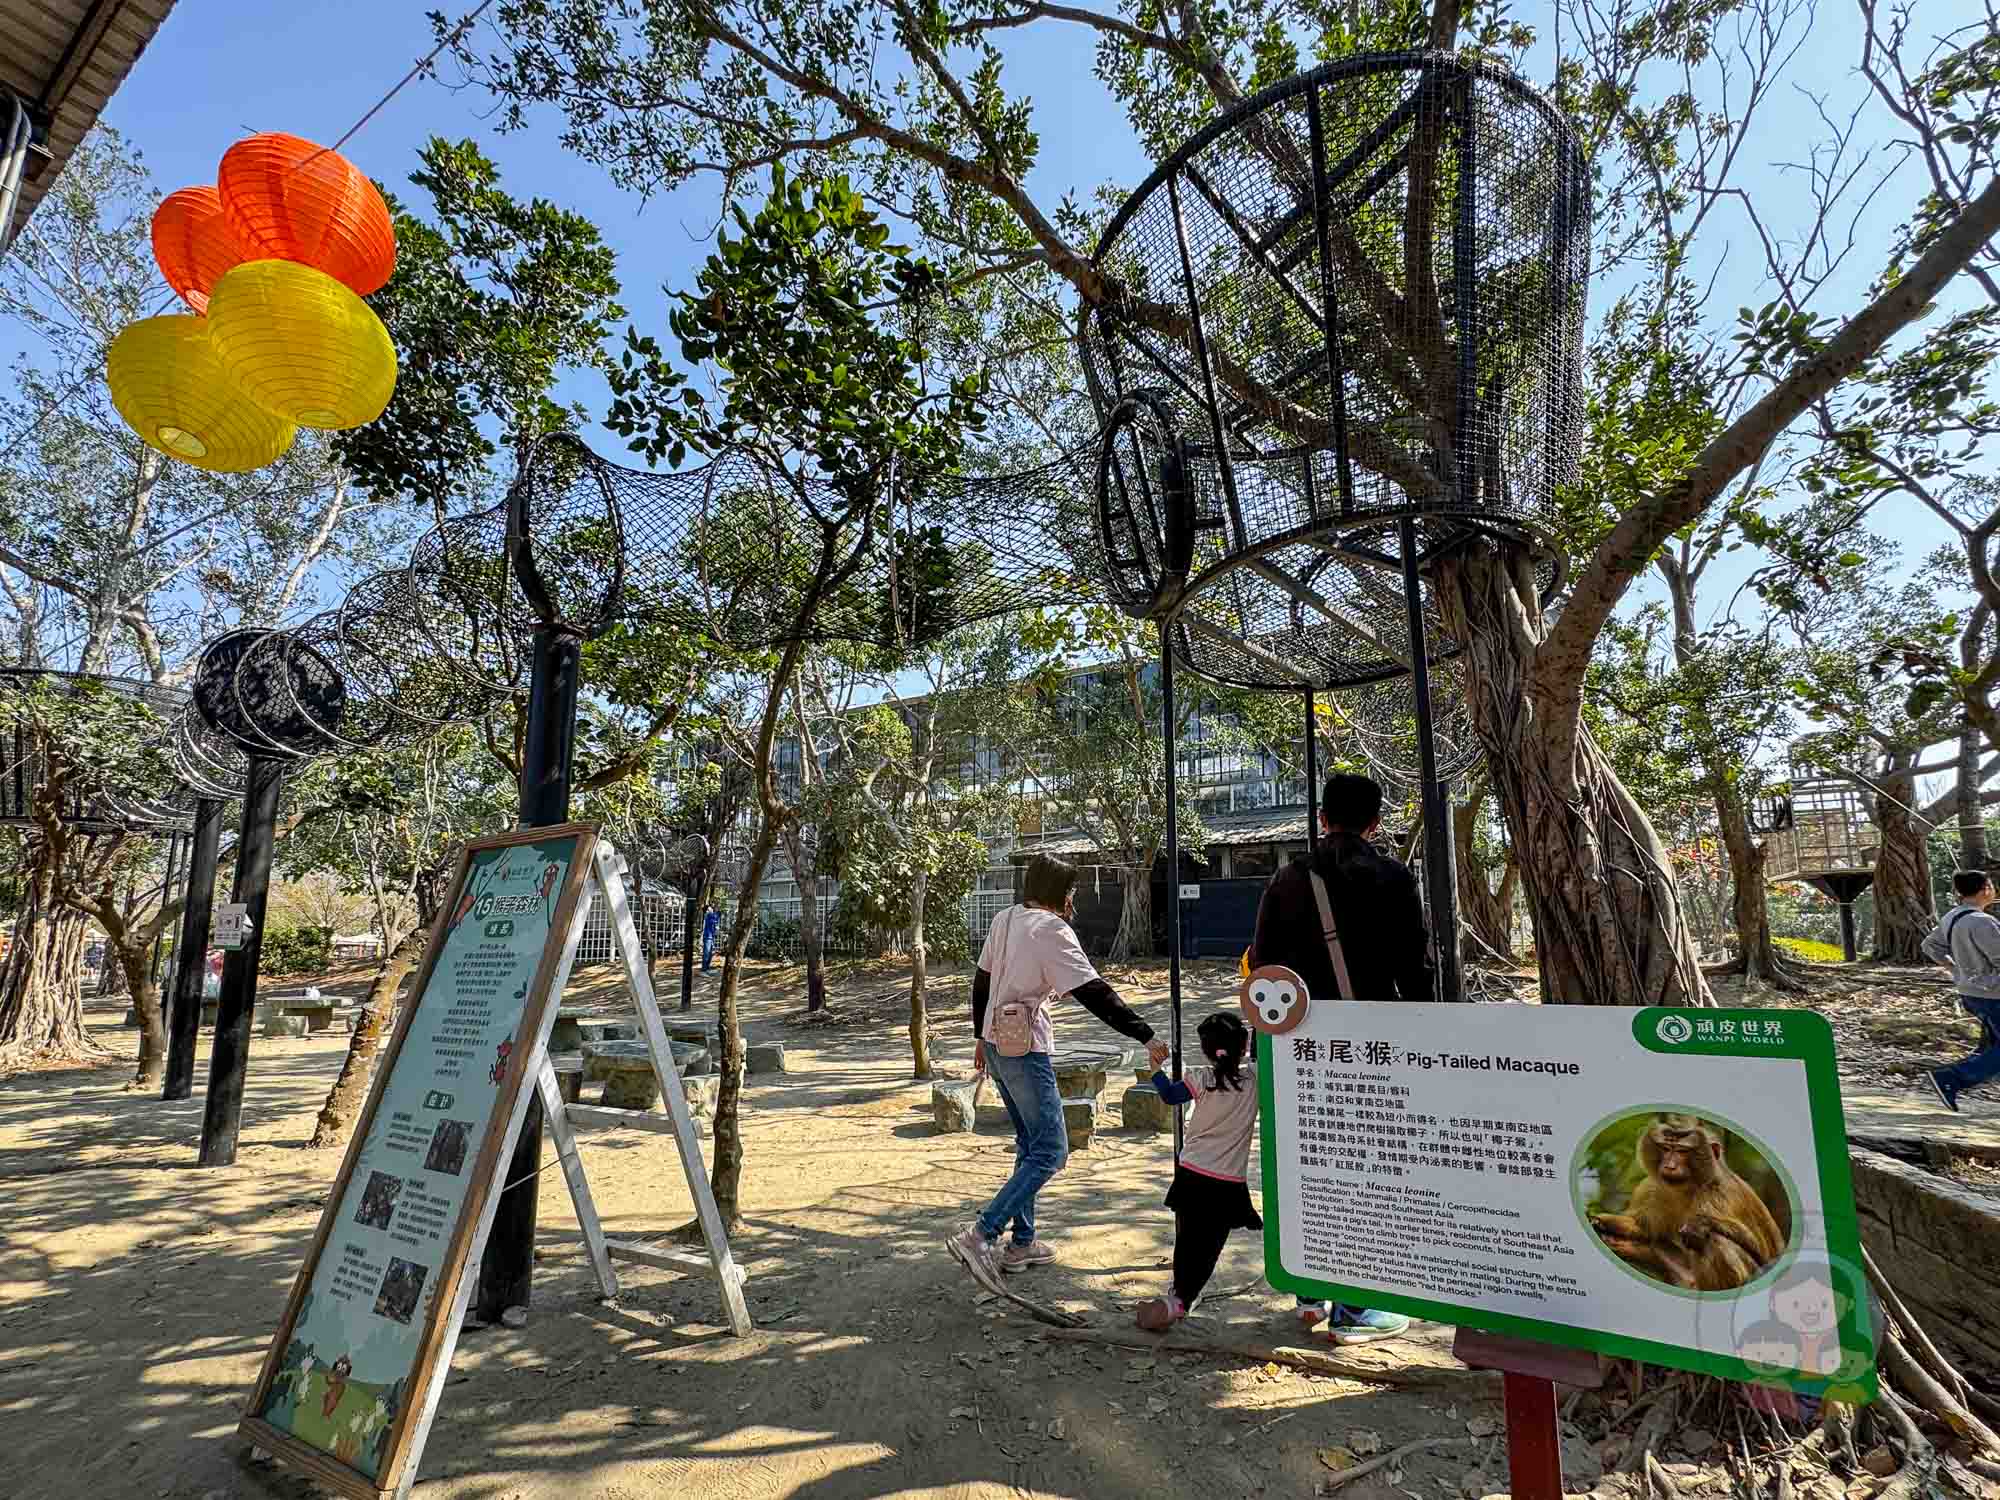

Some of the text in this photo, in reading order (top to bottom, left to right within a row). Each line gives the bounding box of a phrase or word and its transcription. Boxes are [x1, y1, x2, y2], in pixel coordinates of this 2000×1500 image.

[1696, 1019, 1783, 1036] 頑皮世界
[1742, 1035, 1785, 1045] WORLD
[1324, 1069, 1357, 1080] Macaca
[1358, 1070, 1391, 1082] leonine
[1407, 1052, 1490, 1069] Pig-Tailed
[1496, 1056, 1580, 1076] Macaque
[1300, 1176, 1334, 1186] Scientific
[1336, 1179, 1360, 1189] Name
[1365, 1181, 1402, 1194] Macaca
[1404, 1187, 1440, 1198] leonine
[1300, 1183, 1350, 1196] Classification
[1356, 1190, 1398, 1203] Mammalia
[1403, 1196, 1440, 1208] Primates
[1447, 1202, 1520, 1218] Cercopithecidae
[1300, 1192, 1343, 1204] Distribution
[1349, 1198, 1372, 1208] South
[1374, 1202, 1389, 1210] and
[1390, 1203, 1433, 1217] Southeast
[1434, 1209, 1454, 1219] Asia
[1302, 1210, 1341, 1221] resembles
[1349, 1217, 1367, 1226] pig's
[1394, 1223, 1420, 1234] earlier
[1449, 1230, 1492, 1243] residents
[1503, 1237, 1551, 1252] Southeast
[1553, 1244, 1574, 1255] Asia
[1303, 1201, 1316, 1210] The
[1318, 1203, 1354, 1216] pig-tailed
[1356, 1208, 1392, 1220] macaque
[1403, 1214, 1431, 1225] named
[1433, 1218, 1444, 1228] for
[1447, 1220, 1457, 1229] its
[1459, 1223, 1498, 1235] relatively
[1501, 1228, 1524, 1238] short
[1526, 1231, 1540, 1240] tail
[1542, 1232, 1561, 1244] that
[1303, 1227, 1339, 1239] nickname
[1302, 1218, 1326, 1229] would
[1326, 1221, 1343, 1230] train
[1344, 1224, 1364, 1234] them
[1375, 1229, 1397, 1238] climb
[1399, 1232, 1420, 1242] trees
[1432, 1237, 1450, 1247] pick
[1497, 1246, 1526, 1258] hence
[1528, 1250, 1543, 1260] the
[1304, 1235, 1317, 1244] The
[1319, 1238, 1356, 1251] pig-tailed
[1358, 1243, 1394, 1256] macaque
[1396, 1249, 1411, 1259] has
[1420, 1254, 1469, 1268] matriarchal
[1472, 1262, 1497, 1273] social
[1546, 1272, 1576, 1285] where
[1304, 1244, 1332, 1255] females
[1334, 1249, 1350, 1258] with
[1352, 1251, 1377, 1263] higher
[1379, 1256, 1404, 1267] status
[1406, 1260, 1426, 1271] have
[1428, 1263, 1458, 1276] priority
[1505, 1275, 1535, 1289] During
[1538, 1281, 1553, 1291] the
[1556, 1284, 1586, 1296] estrus
[1304, 1262, 1338, 1274] resulting
[1346, 1269, 1360, 1278] the
[1361, 1271, 1416, 1287] characteristic
[1331, 1257, 1371, 1272] influenced
[1430, 1273, 1444, 1283] the
[1446, 1277, 1481, 1289] perineal
[1484, 1282, 1512, 1295] region
